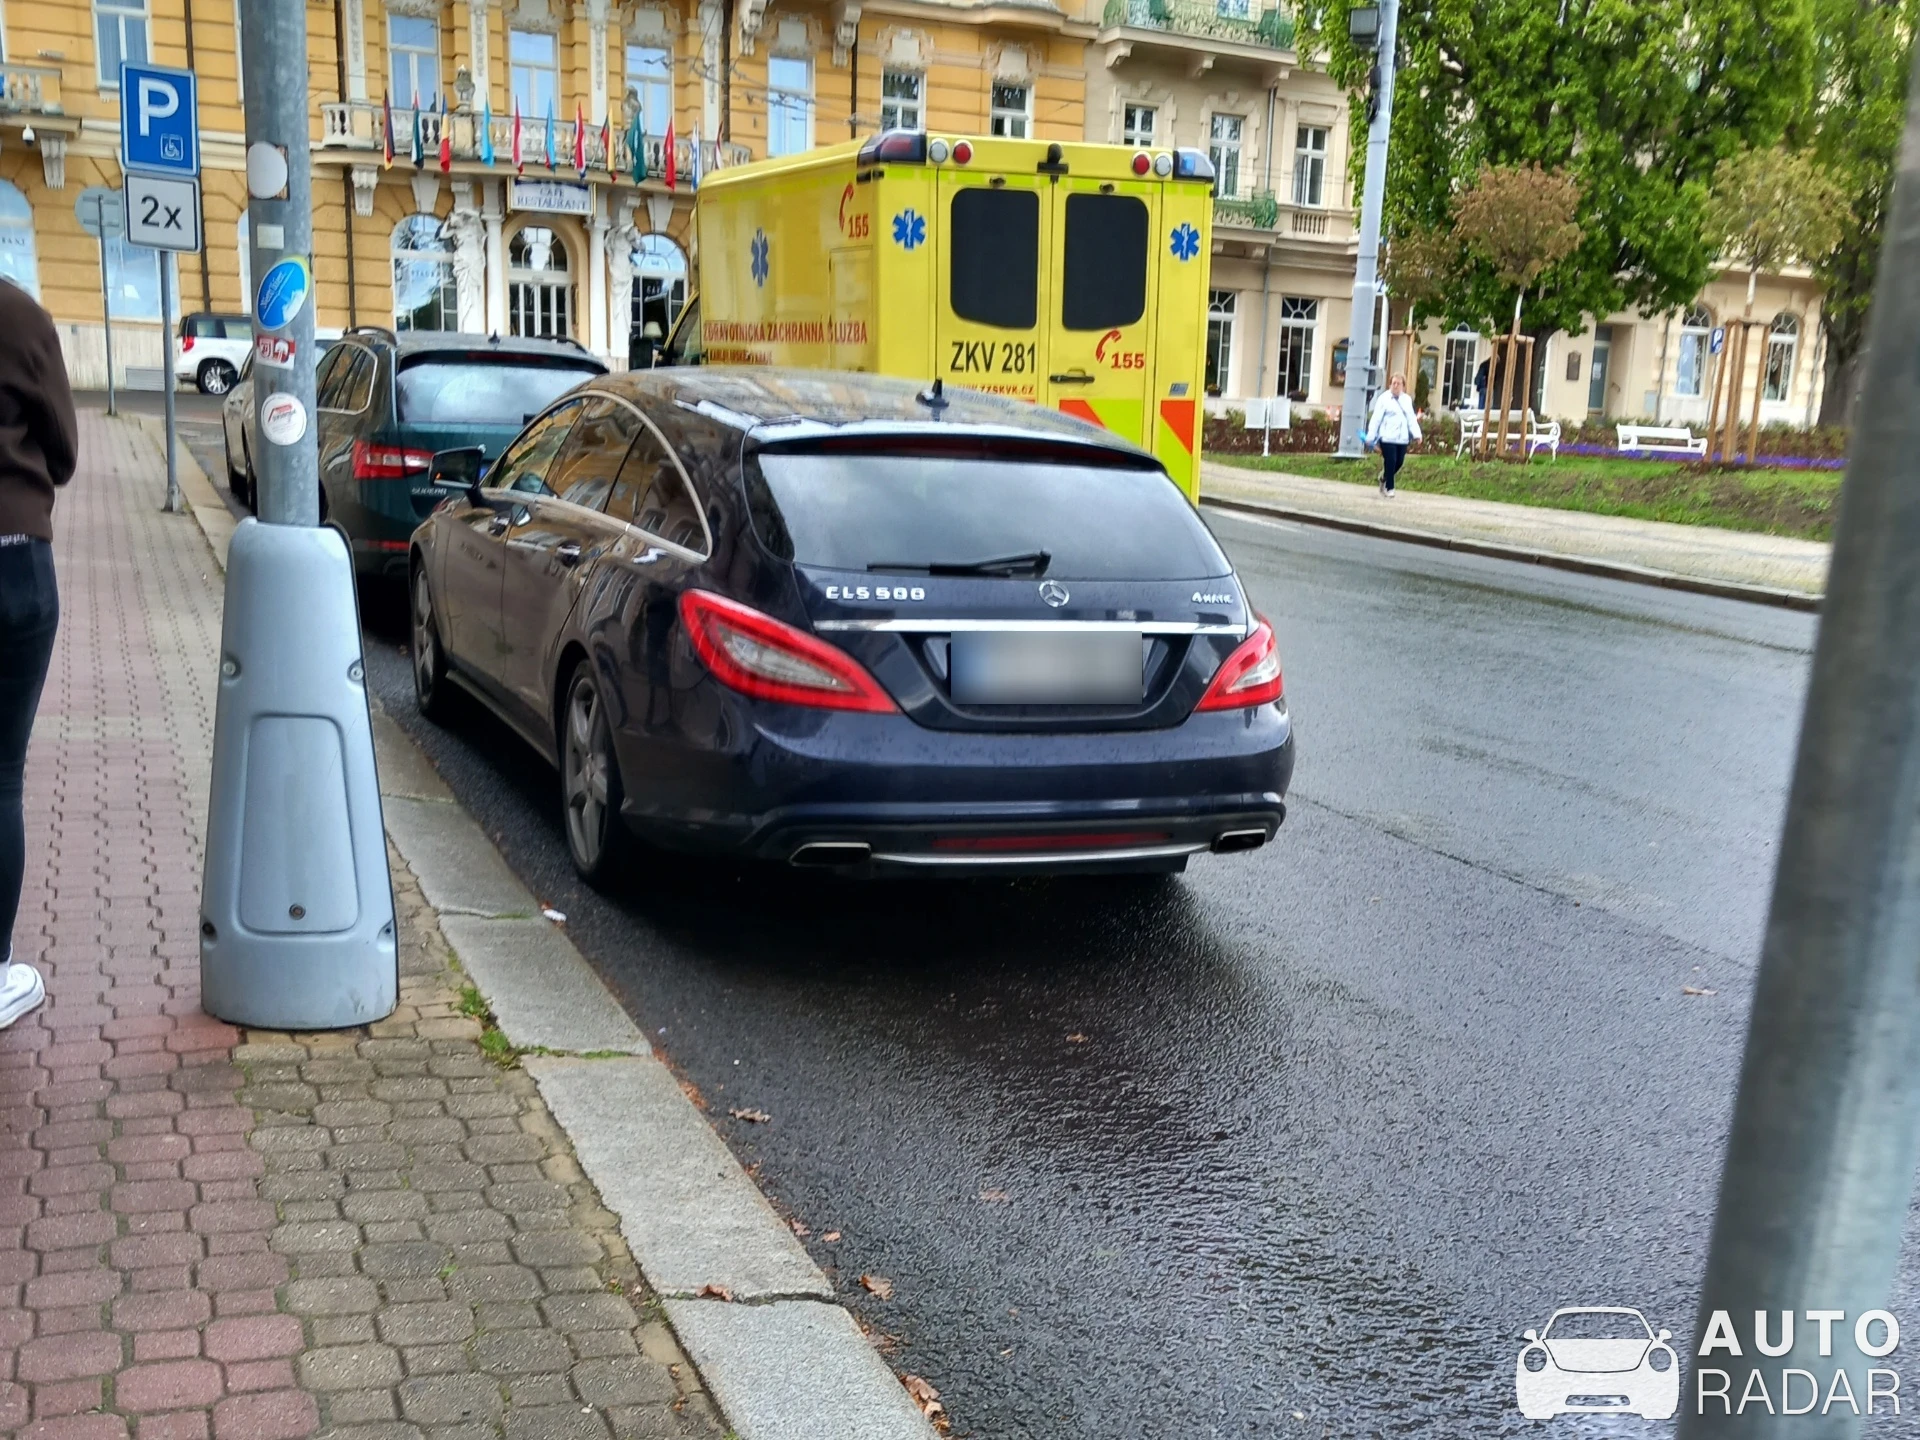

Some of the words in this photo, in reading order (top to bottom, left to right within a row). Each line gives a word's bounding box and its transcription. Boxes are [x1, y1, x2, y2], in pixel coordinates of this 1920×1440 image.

[138, 77, 180, 137] P
[140, 194, 183, 231] 2x
[517, 196, 586, 210] RESTAURANT
[848, 213, 869, 239] 155
[950, 340, 995, 373] ZKV
[1001, 341, 1036, 373] 281
[1110, 351, 1145, 369] 155
[825, 586, 870, 600] CLS
[875, 586, 926, 601] 500
